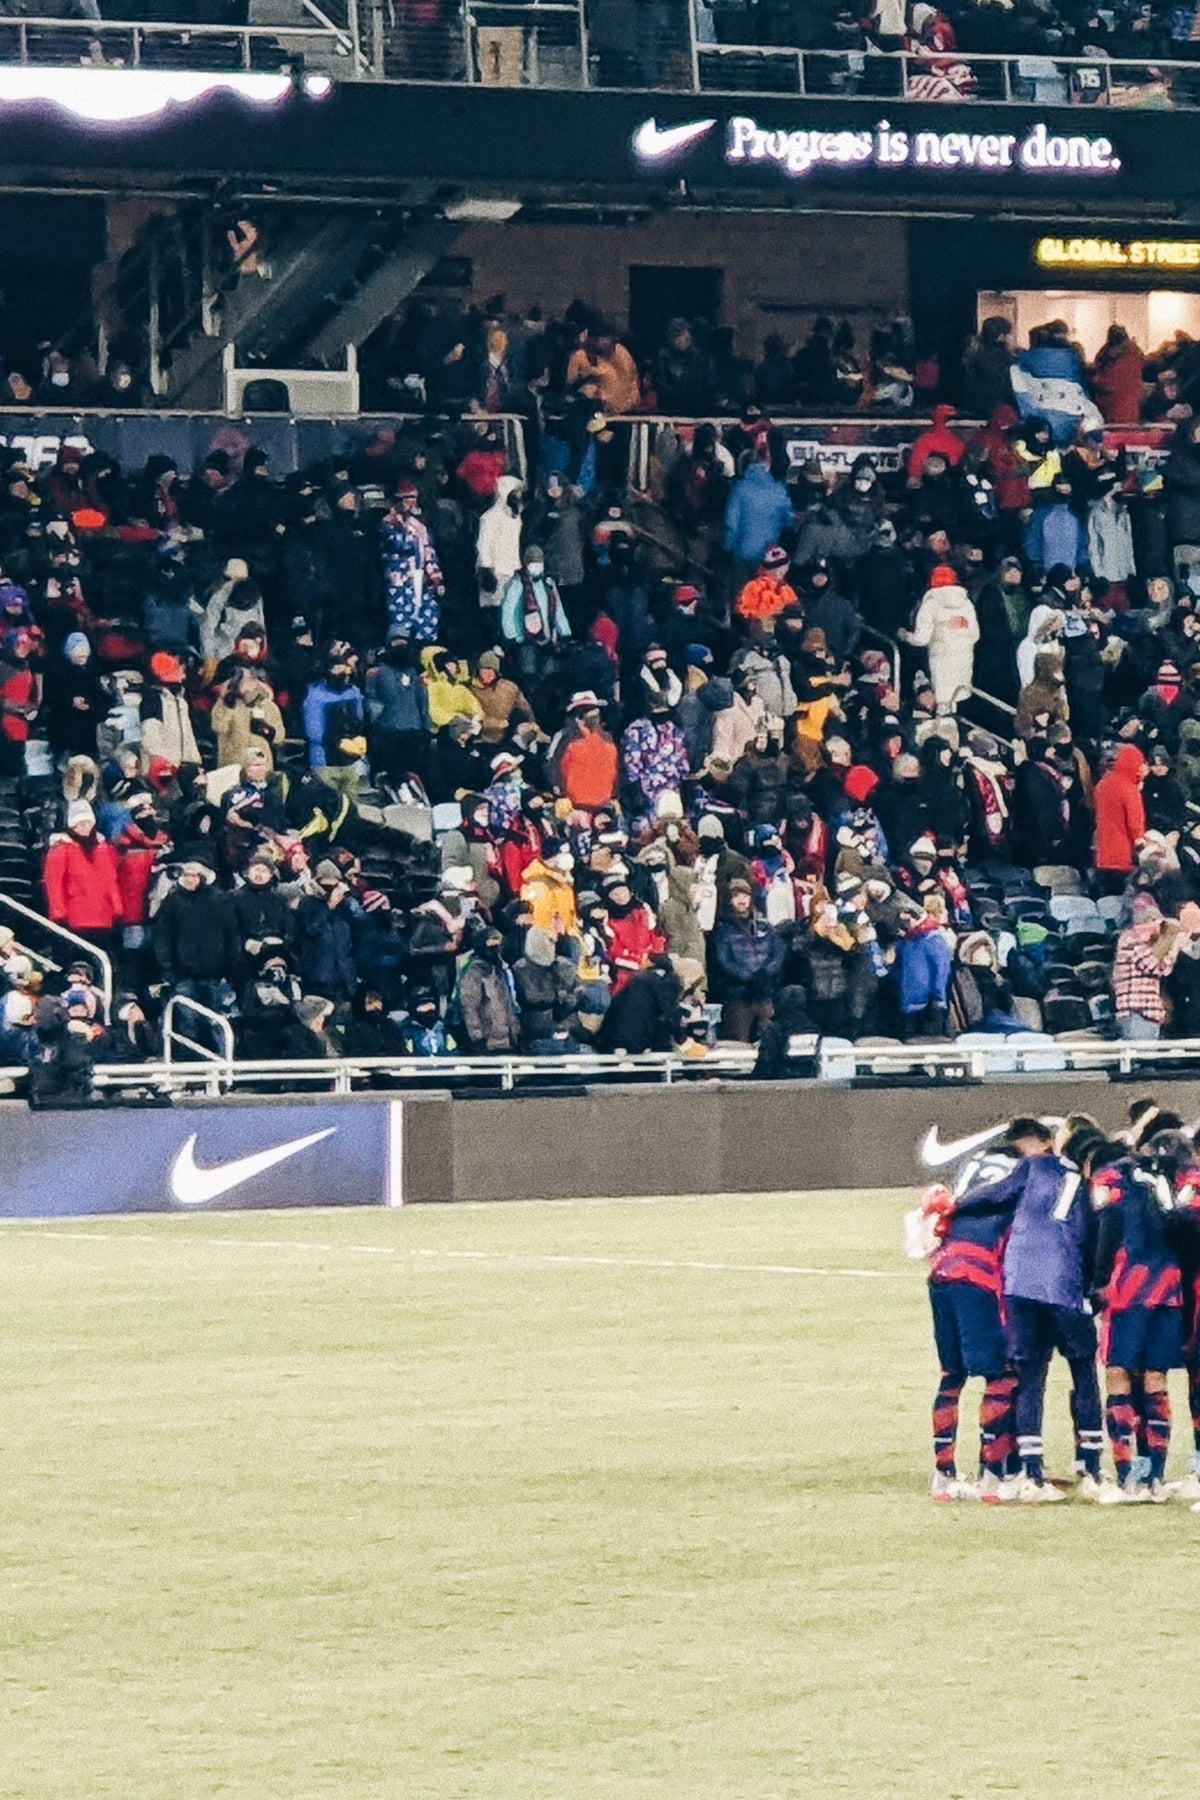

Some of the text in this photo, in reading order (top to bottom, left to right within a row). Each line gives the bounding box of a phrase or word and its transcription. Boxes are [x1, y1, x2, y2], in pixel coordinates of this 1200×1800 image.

[726, 116, 1122, 172] Progress is never done.
[1038, 238, 1128, 264] GLOBAL
